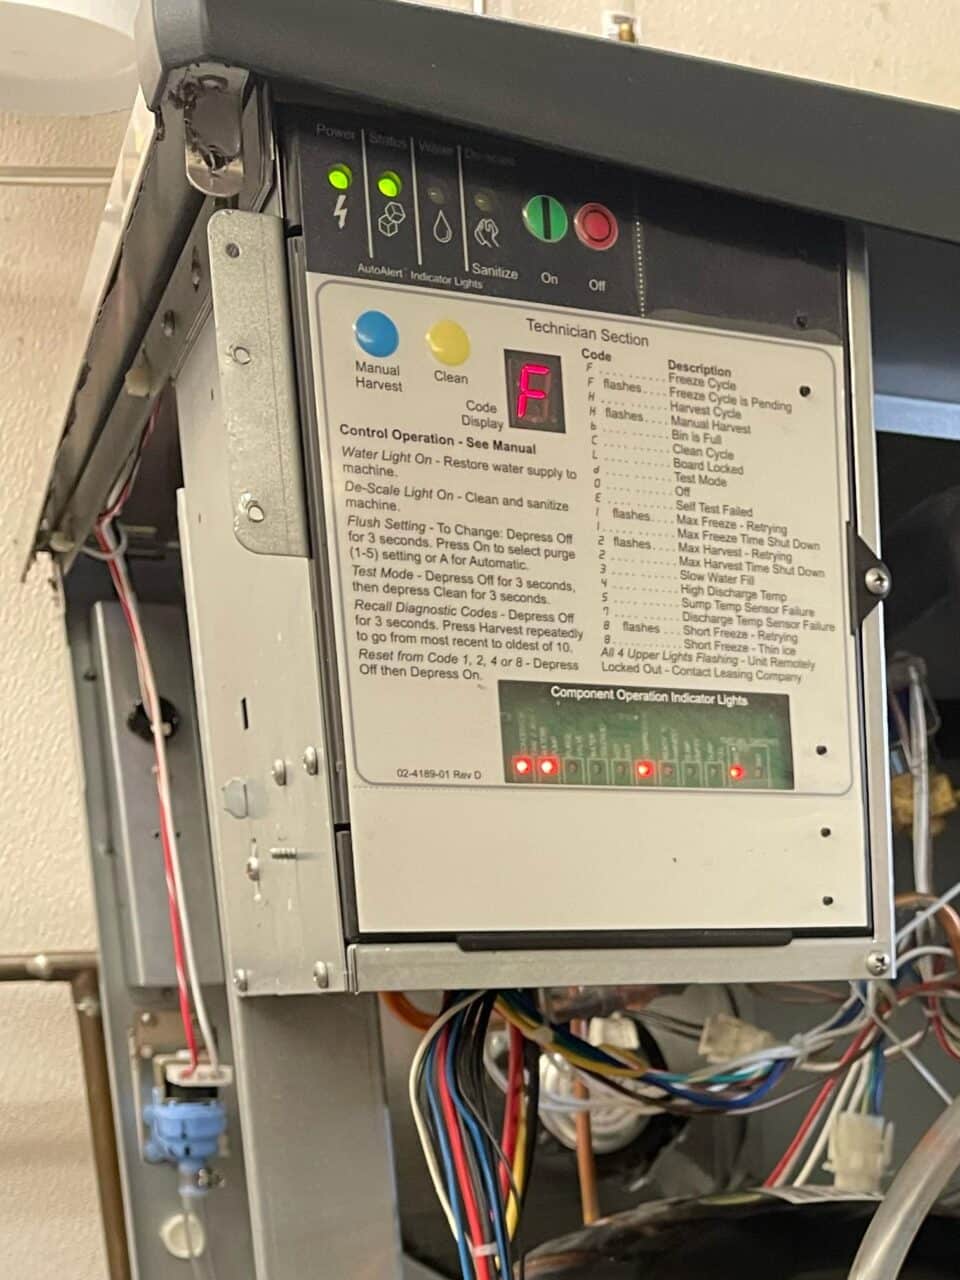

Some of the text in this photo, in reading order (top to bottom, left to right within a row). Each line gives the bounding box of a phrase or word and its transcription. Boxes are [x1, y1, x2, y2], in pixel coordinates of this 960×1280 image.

[316, 123, 356, 140] Power
[410, 271, 451, 285] Indicator
[454, 277, 484, 290] Lights
[472, 262, 519, 280] Sanitize
[540, 271, 559, 285] On
[588, 279, 606, 292] Off
[525, 317, 649, 347] Technician Section
[581, 347, 612, 362] Code
[355, 360, 400, 376] Manual
[434, 370, 469, 385] Clean
[667, 359, 732, 378] Description
[355, 376, 403, 392] Harvest
[516, 364, 550, 418] F
[668, 372, 737, 392] Freeze Cycle
[465, 399, 497, 414] Code
[670, 400, 742, 420] Harvest Cycle
[461, 414, 504, 432] Display
[670, 414, 752, 434] Manual Harvest
[339, 423, 536, 455] Control Operation See Manual
[672, 443, 735, 461] Clean Cycle
[341, 445, 577, 481] Water Light On Restore water supply to
[342, 463, 398, 477] machine.
[673, 457, 744, 476] Board Locked
[673, 471, 728, 488] Test Mode
[345, 480, 569, 512] De-Scale Light On Clean and sanitize
[674, 485, 691, 498] Off
[345, 498, 400, 512] machine.
[676, 499, 753, 518] Self Test Failed
[347, 514, 573, 544] Flush Setting To Change: Depress Off
[676, 513, 788, 537] Max Freeze Retrying
[348, 530, 576, 562] for seconds. Press On to select purge
[677, 527, 820, 550] Max Freeze Time Shut Down
[349, 546, 528, 570] (1-5) setting or for Automatic.
[351, 564, 575, 593] Test Mode Depress Off for seconds,
[352, 581, 550, 605] then depress Clean for seconds.
[680, 583, 788, 604] High Discharge Temp
[354, 598, 575, 624] Recall Diagnostic Codes Depress Off
[355, 614, 583, 642] for seconds. Press Harvest repeatedly
[356, 630, 573, 653] to go from most recent to oldest of 10.
[358, 648, 579, 672] Reset from Code 1, 2, or Depress
[600, 646, 815, 672] All Upper Lights Flashing Unit Remotely
[359, 663, 482, 680] Off then Depress On.
[601, 661, 802, 684] Locked Out Contact Leasing Company
[550, 685, 748, 708] Component Operation Indicator Lights
[396, 768, 472, 780] 02-4189-01 Rev
